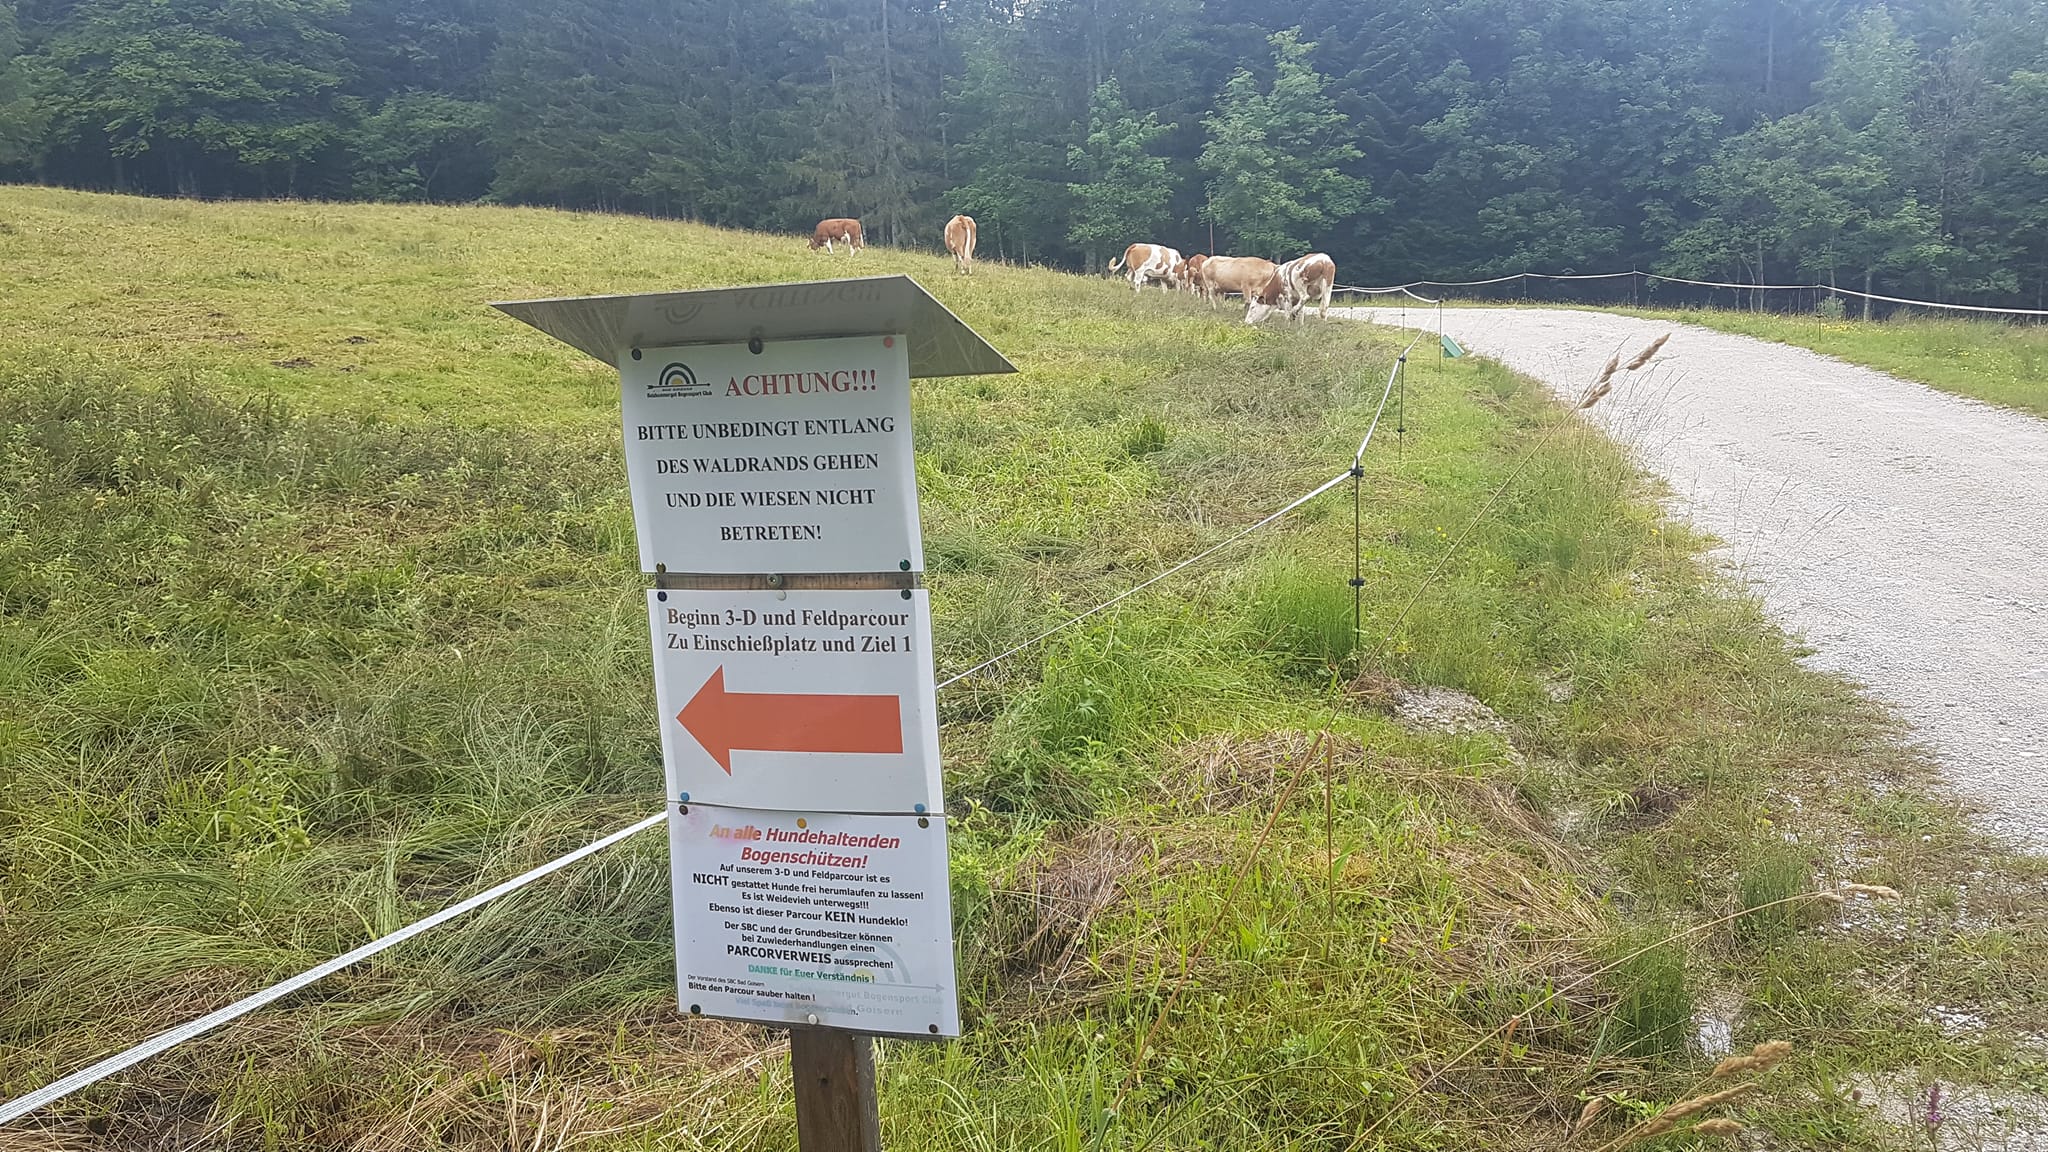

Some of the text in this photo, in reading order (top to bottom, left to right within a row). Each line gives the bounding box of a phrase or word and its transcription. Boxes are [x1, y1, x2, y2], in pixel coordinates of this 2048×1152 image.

[725, 369, 877, 397] ACHTUNG!!!
[637, 416, 895, 441] BITTE UNBEDINGT ENTLANG
[657, 453, 879, 475] DES WALDRANDS GEHEN
[666, 488, 876, 508] UND DIE WIESEN NICHT
[720, 524, 822, 542] BETRETEN!
[667, 608, 909, 630] Beginn 3-D und Feldparcour
[667, 633, 912, 656] Zu Einschießplatz und Ziel 1
[709, 824, 900, 849] An alle Hundehaltenden
[741, 847, 868, 868] Bogenschützen!
[720, 864, 735, 872] Auf
[736, 865, 772, 875] unserem
[774, 868, 790, 876] 3-D
[793, 869, 809, 878] und
[812, 870, 864, 882] Feldparcour
[866, 874, 877, 882] ist
[693, 873, 729, 886] NICHT
[731, 879, 770, 889] gestattet
[771, 882, 800, 892] Hunde
[802, 884, 817, 893] frei
[819, 886, 875, 897] herumlaufen
[891, 890, 924, 900] lassen!
[742, 892, 869, 910] Es ist Weidevieh unterwegs!!!
[709, 903, 908, 927] Ebenso ist dieser Parcour KEIN Hundeklo!
[725, 921, 893, 943] Der SBC und der Grundbesitzer können
[742, 934, 875, 953] bei Zuwiederhandlungen einen
[727, 945, 894, 969] PARCORVERWEIS aussprechen!
[748, 964, 778, 975] DANKE
[780, 967, 793, 976] für
[795, 969, 815, 978] Euer
[817, 971, 870, 983] Verständnis
[689, 982, 707, 991] Bitte
[708, 984, 723, 992] den
[725, 985, 755, 996] Parcour
[756, 988, 783, 998] sauber
[785, 991, 811, 1001] halten
